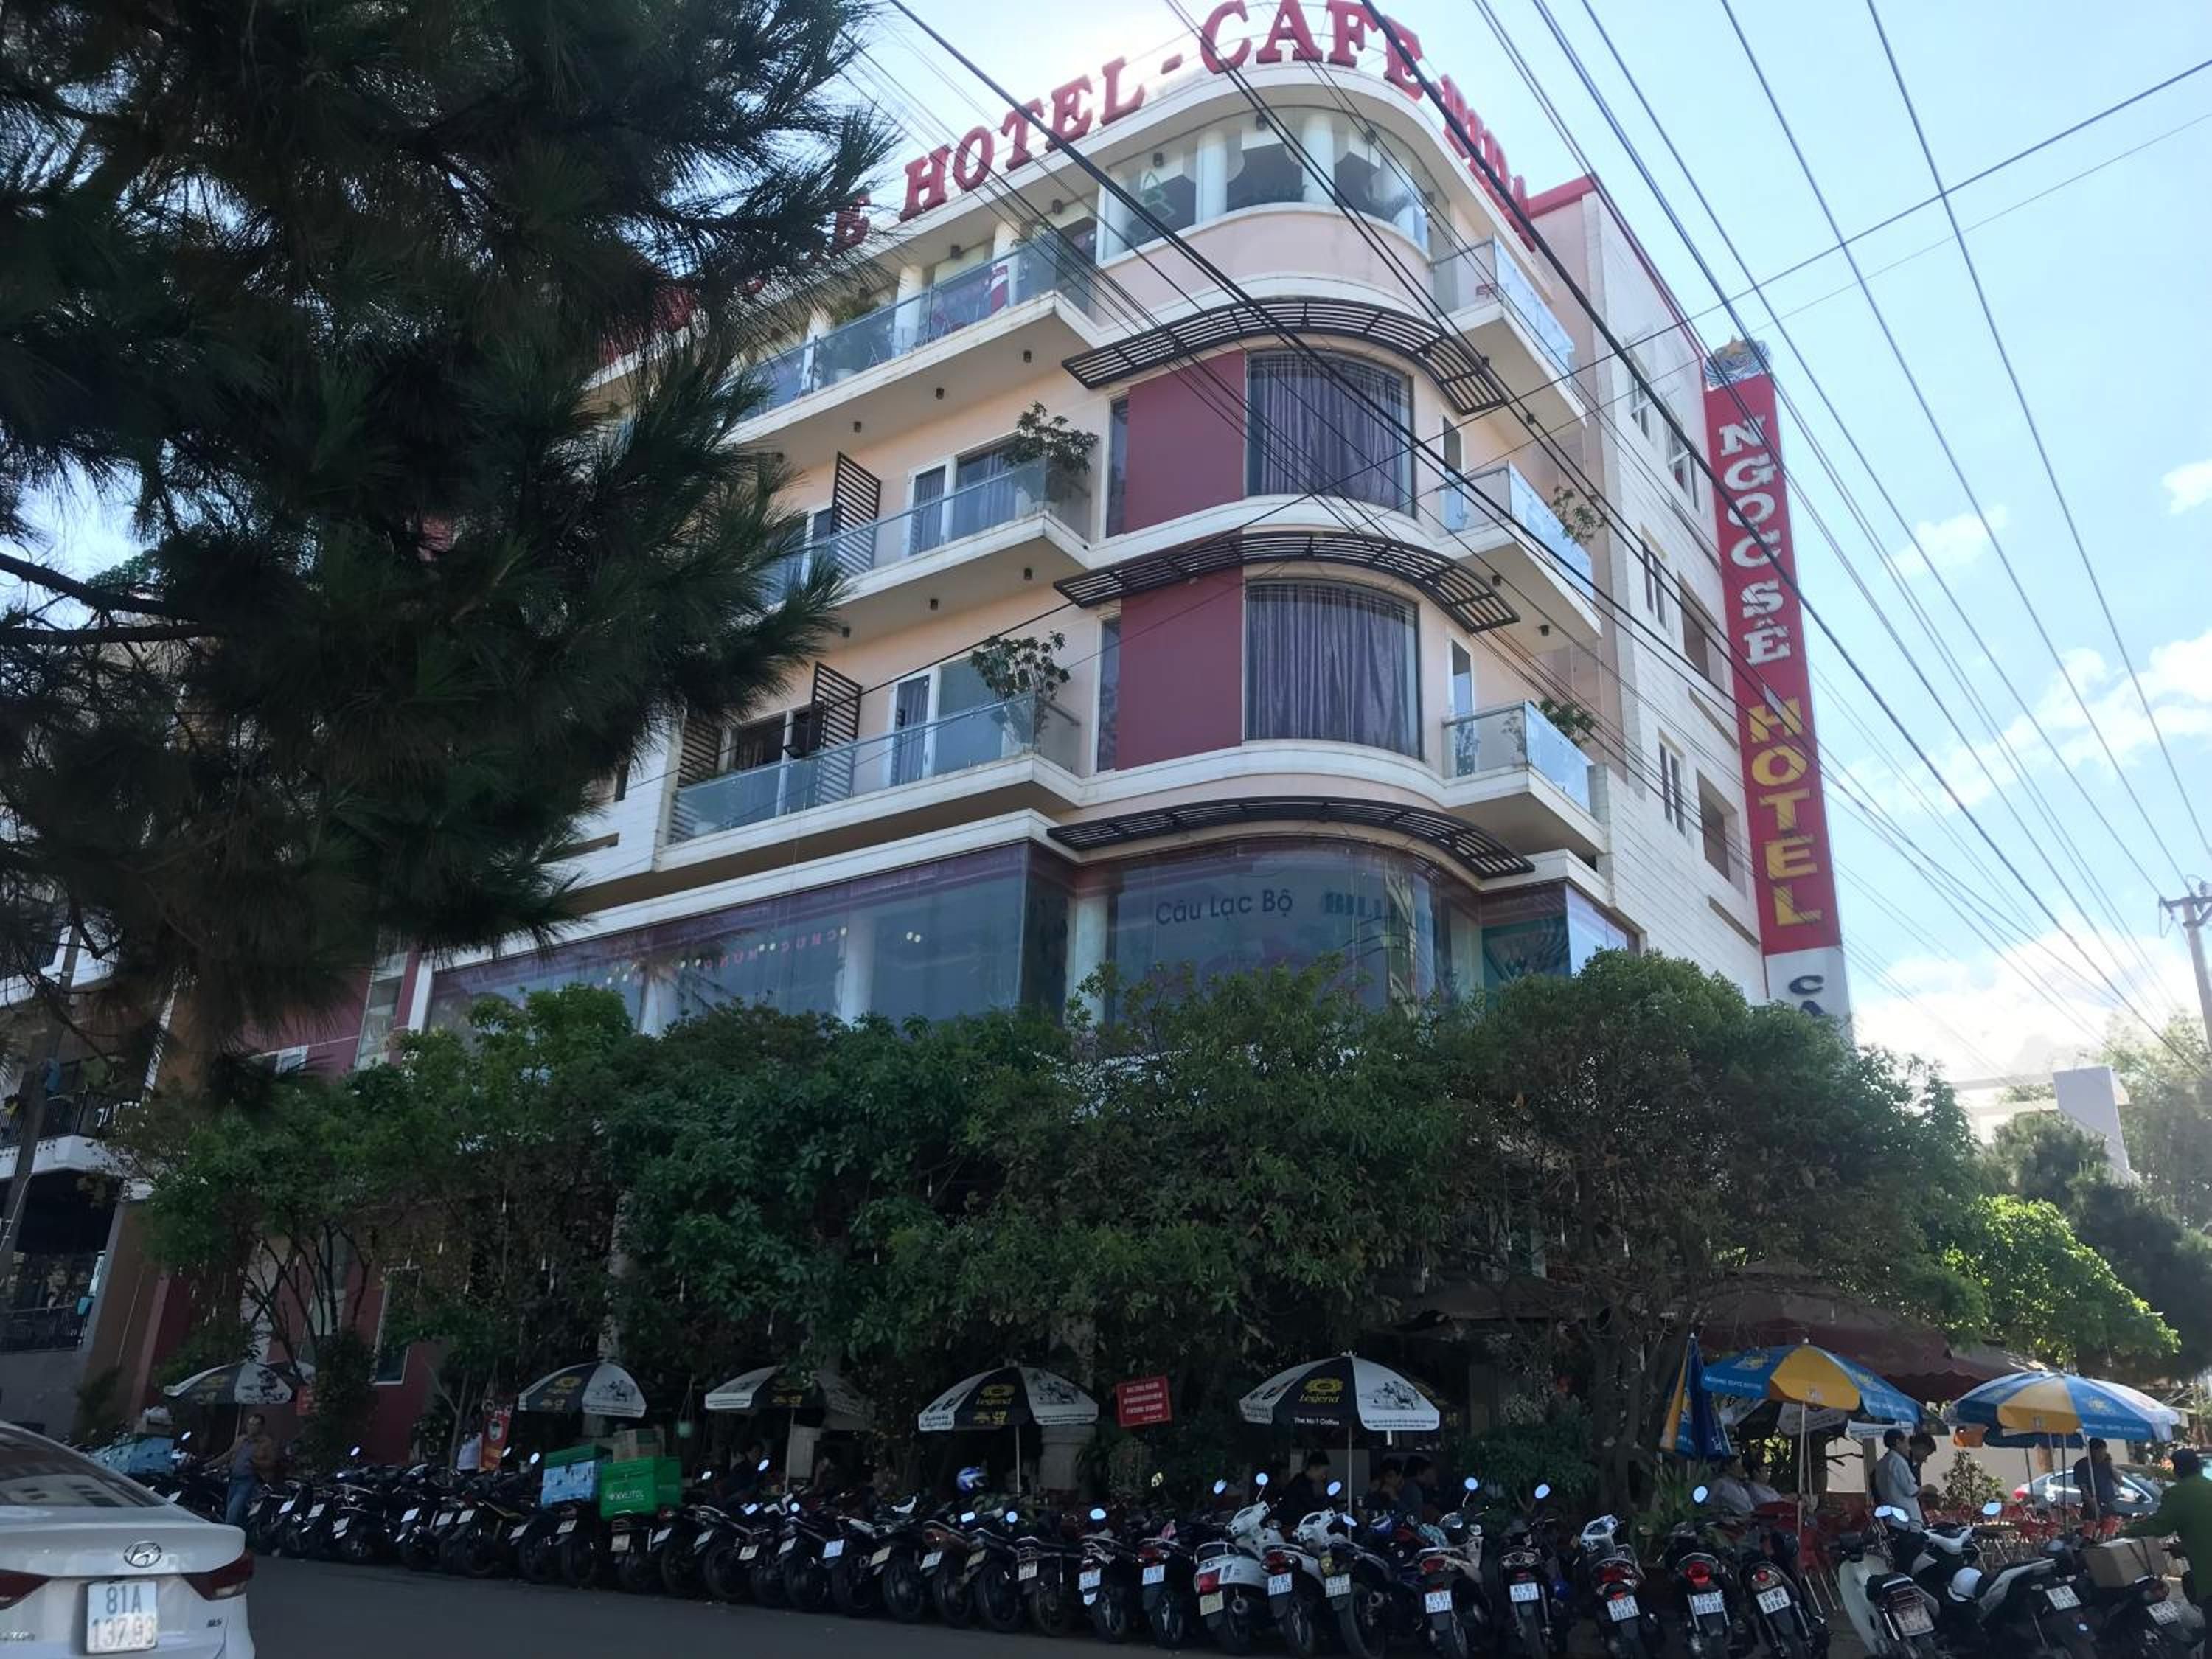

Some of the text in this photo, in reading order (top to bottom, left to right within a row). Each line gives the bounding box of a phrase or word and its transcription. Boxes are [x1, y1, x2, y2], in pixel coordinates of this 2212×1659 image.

[898, 55, 1147, 222] HOTEL
[1199, 0, 1426, 102] CAFE
[1747, 696, 1823, 928] HOTEL
[1262, 888, 1293, 918] Bộ
[105, 1585, 142, 1615] 81A
